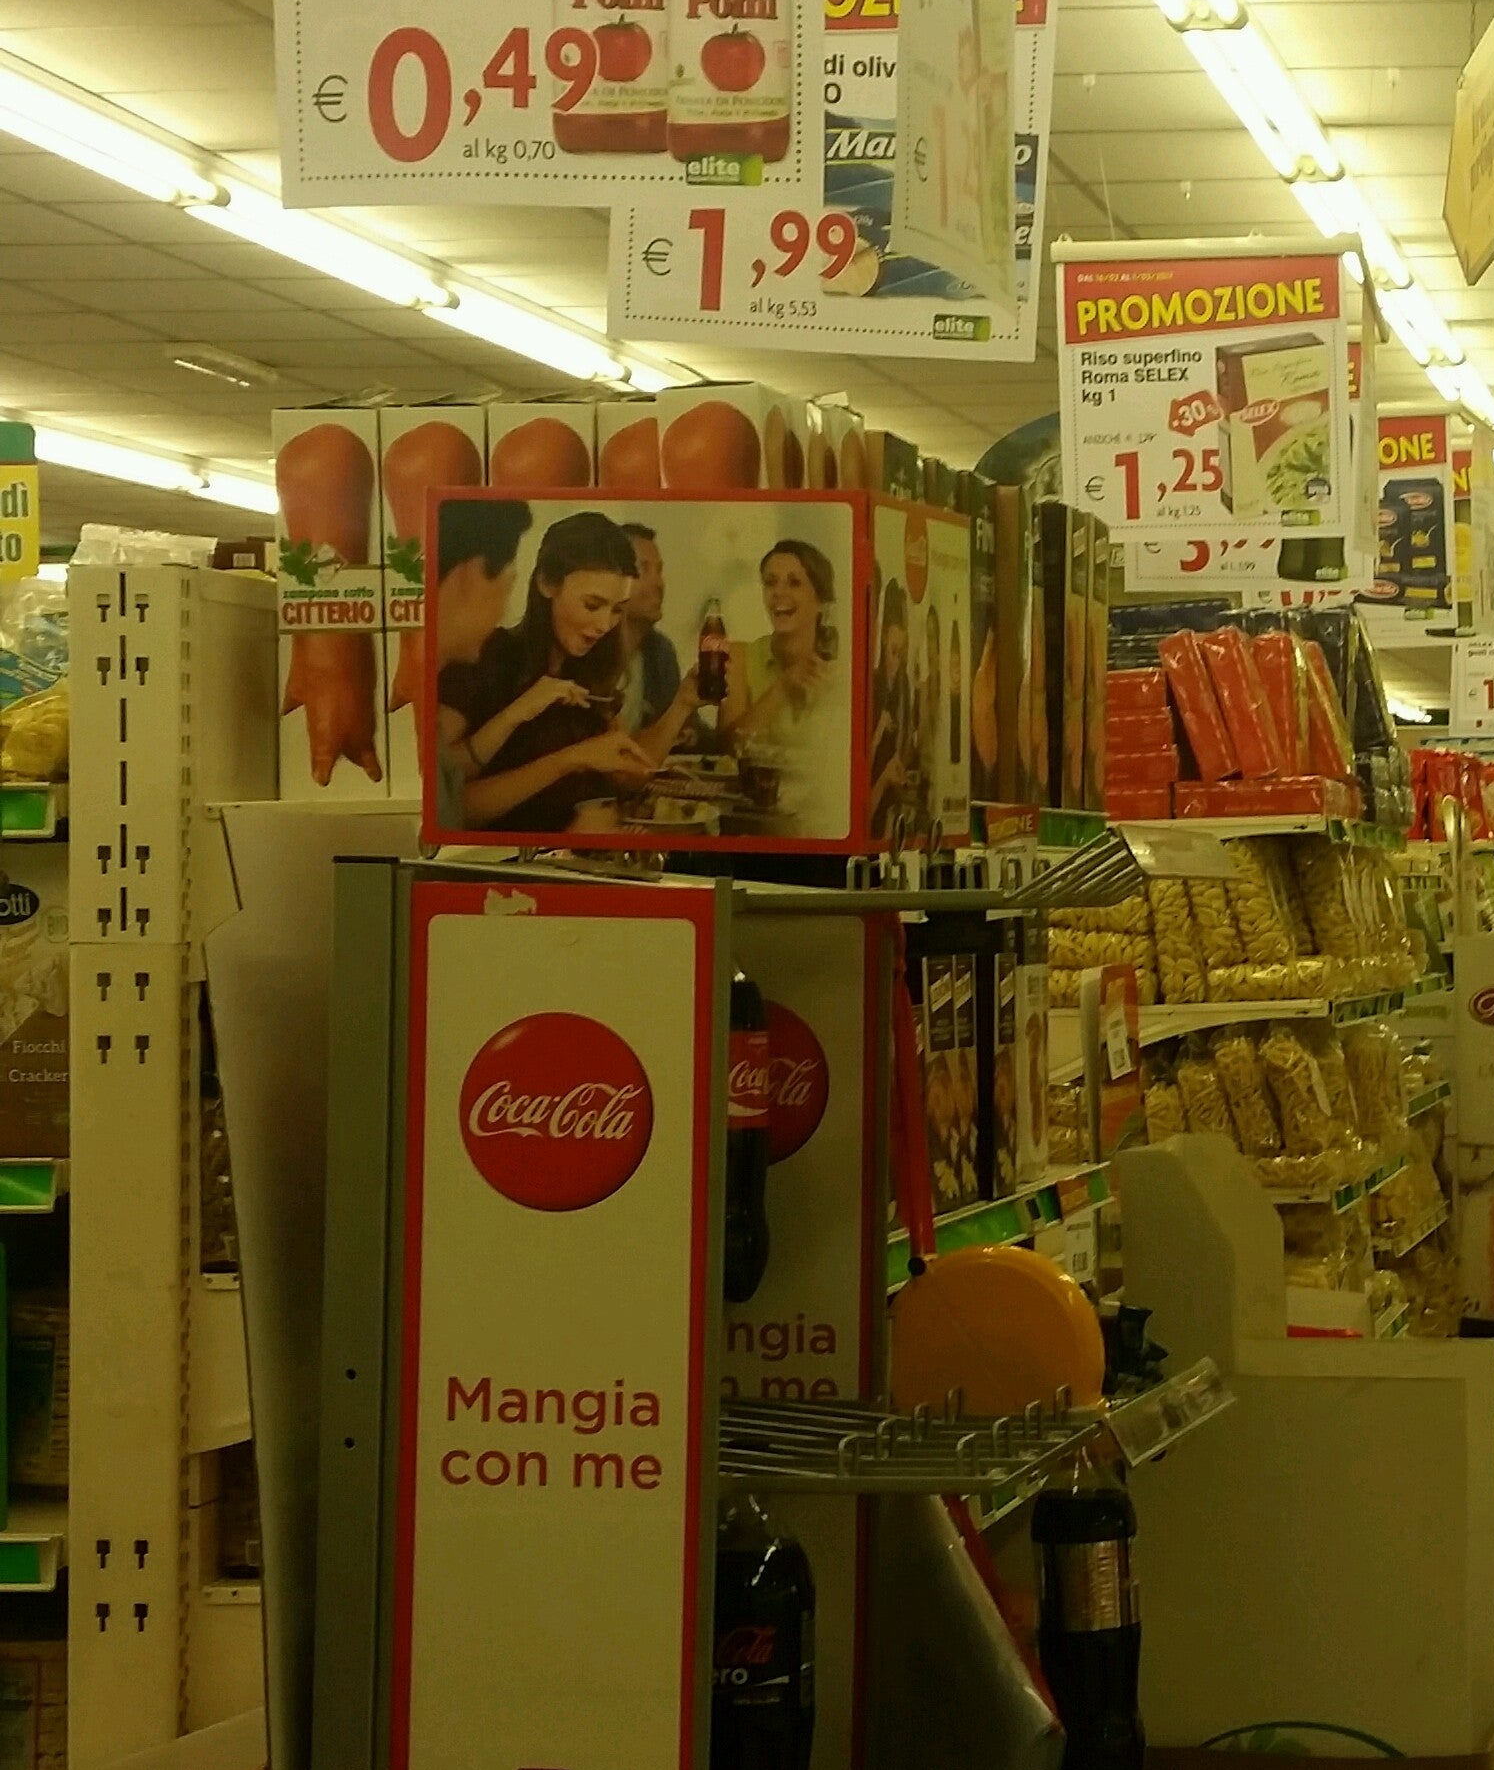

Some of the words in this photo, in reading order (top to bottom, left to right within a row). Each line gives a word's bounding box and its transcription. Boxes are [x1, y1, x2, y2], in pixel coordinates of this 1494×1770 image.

[312, 74, 348, 122] €
[462, 139, 479, 159] al
[486, 138, 507, 164] kg
[513, 139, 556, 161] 0,70
[687, 156, 741, 176] elite
[642, 237, 674, 276] €
[767, 300, 785, 317] kg
[1076, 277, 1325, 336] PROMOZIONE
[1081, 350, 1118, 367] Riso
[1123, 348, 1203, 367] superfino
[1081, 367, 1129, 385] Roma
[1134, 367, 1188, 382] SELEX
[1081, 388, 1102, 406] kg
[1108, 388, 1116, 403] 1
[1084, 475, 1106, 501] €
[1114, 448, 1224, 521] 1,25
[282, 599, 376, 625] CITTERIO
[12, 1039, 66, 1054] Fiocchi
[8, 1068, 68, 1084] Cracker
[446, 1376, 661, 1435] Mangia
[440, 1447, 548, 1489] con
[573, 1450, 663, 1490] me
